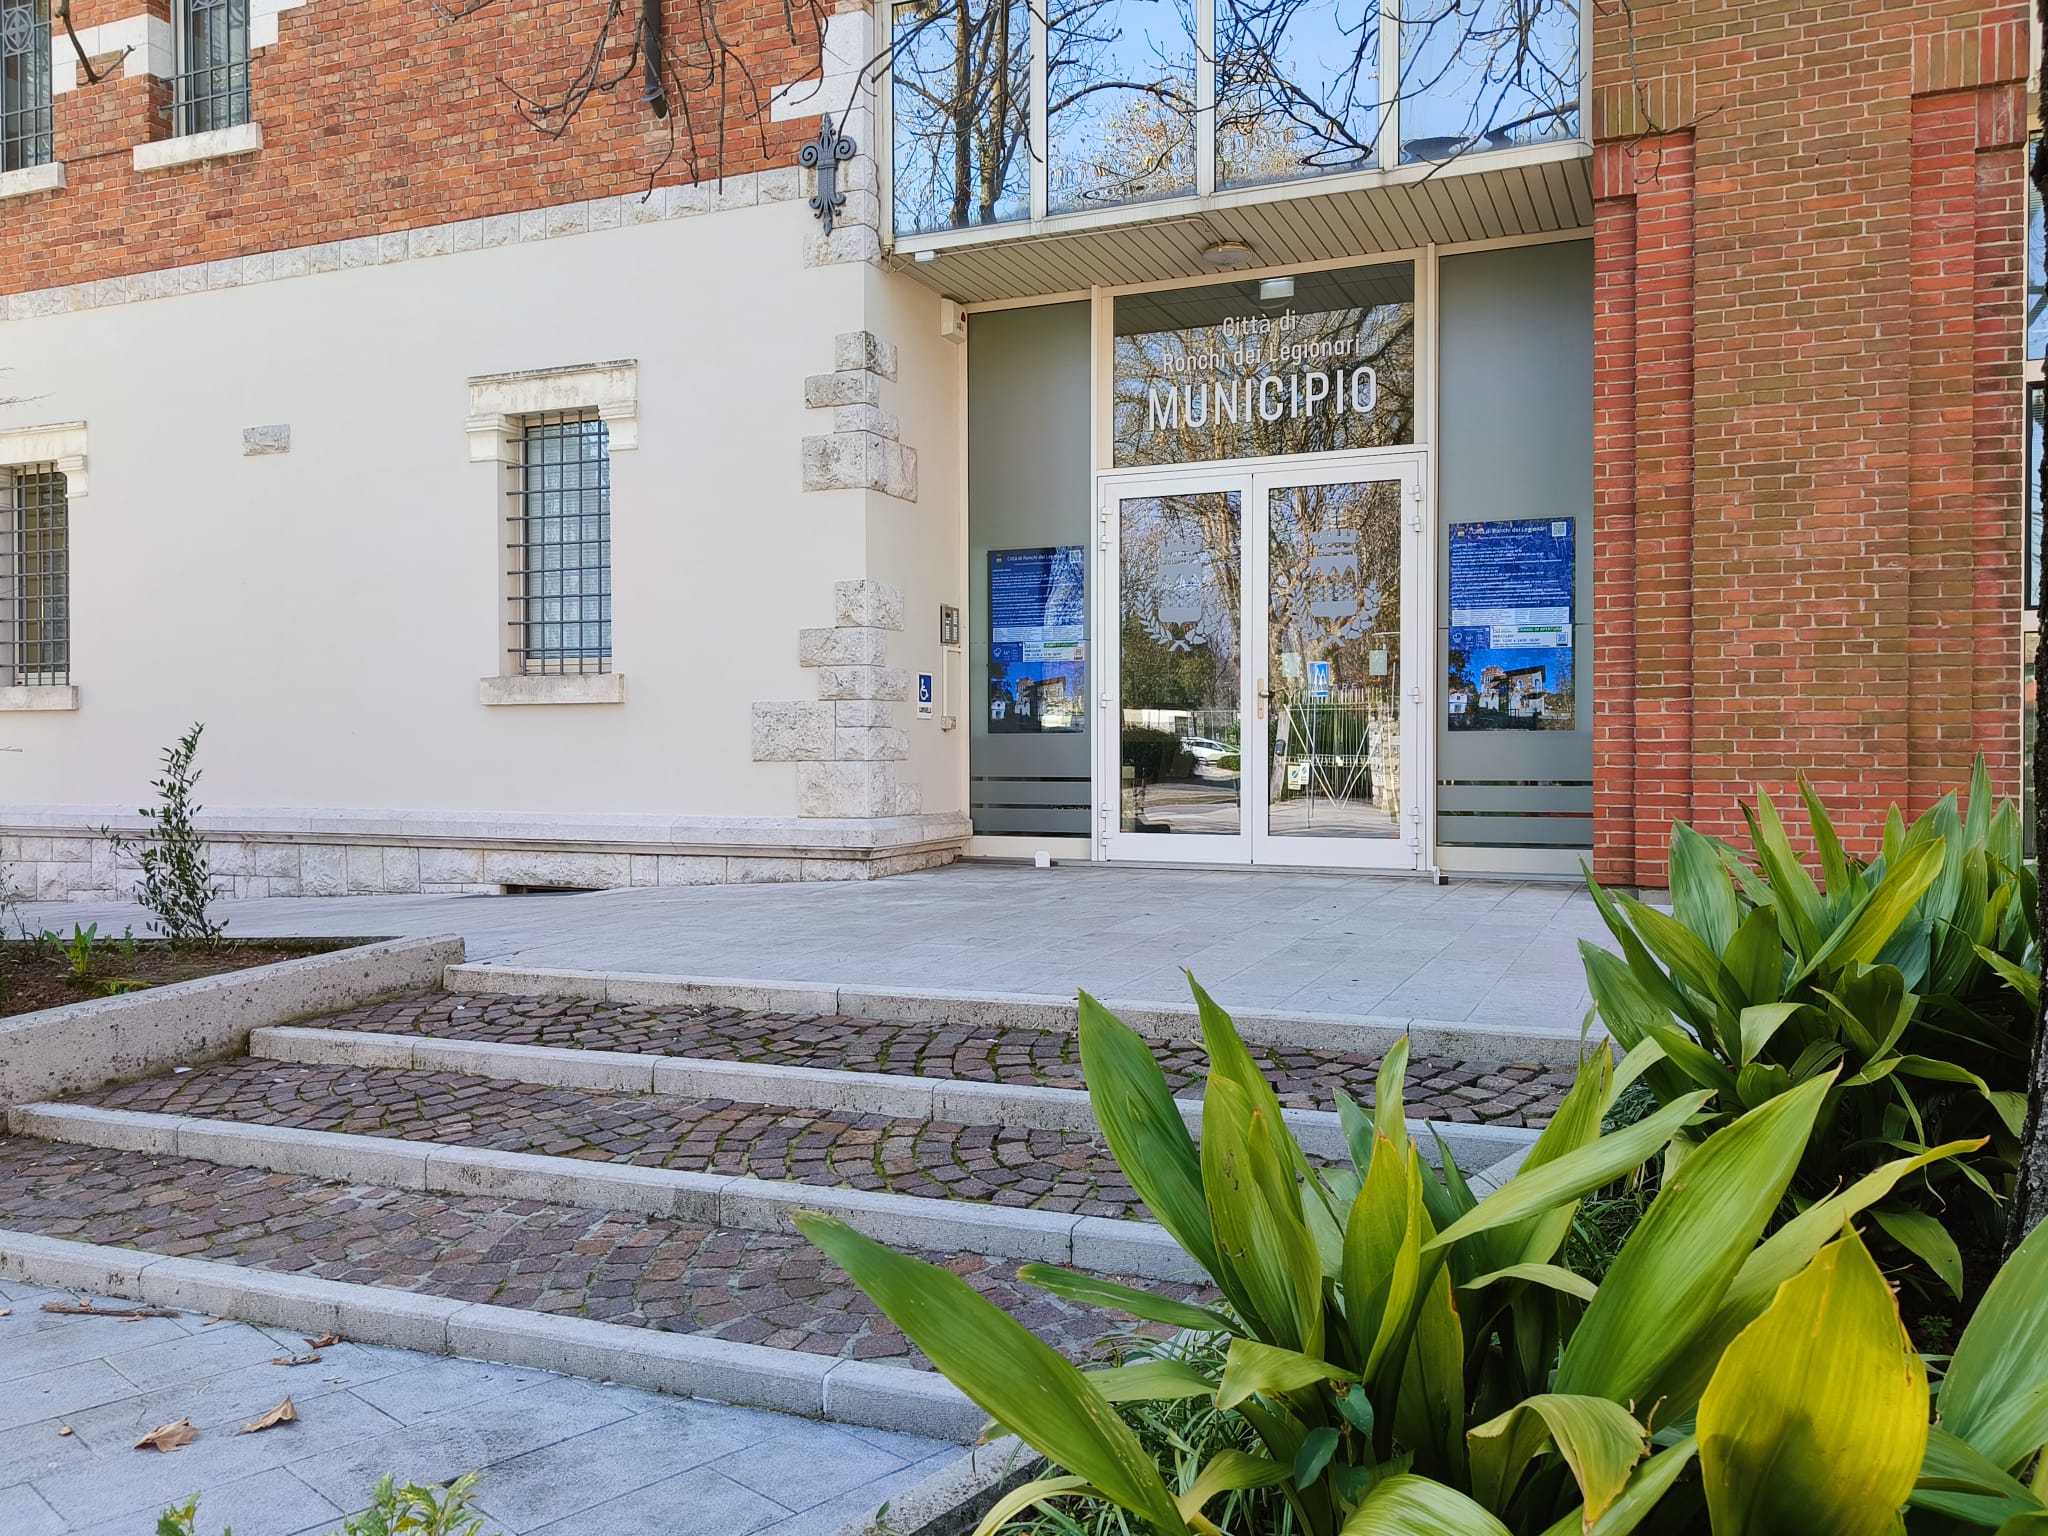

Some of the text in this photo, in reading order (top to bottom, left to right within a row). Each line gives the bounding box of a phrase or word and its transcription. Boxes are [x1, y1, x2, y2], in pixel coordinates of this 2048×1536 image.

[1222, 308, 1297, 338] Città di
[1163, 334, 1360, 374] Ronchi dei Legionari
[1148, 366, 1377, 432] MUNICIPIO
